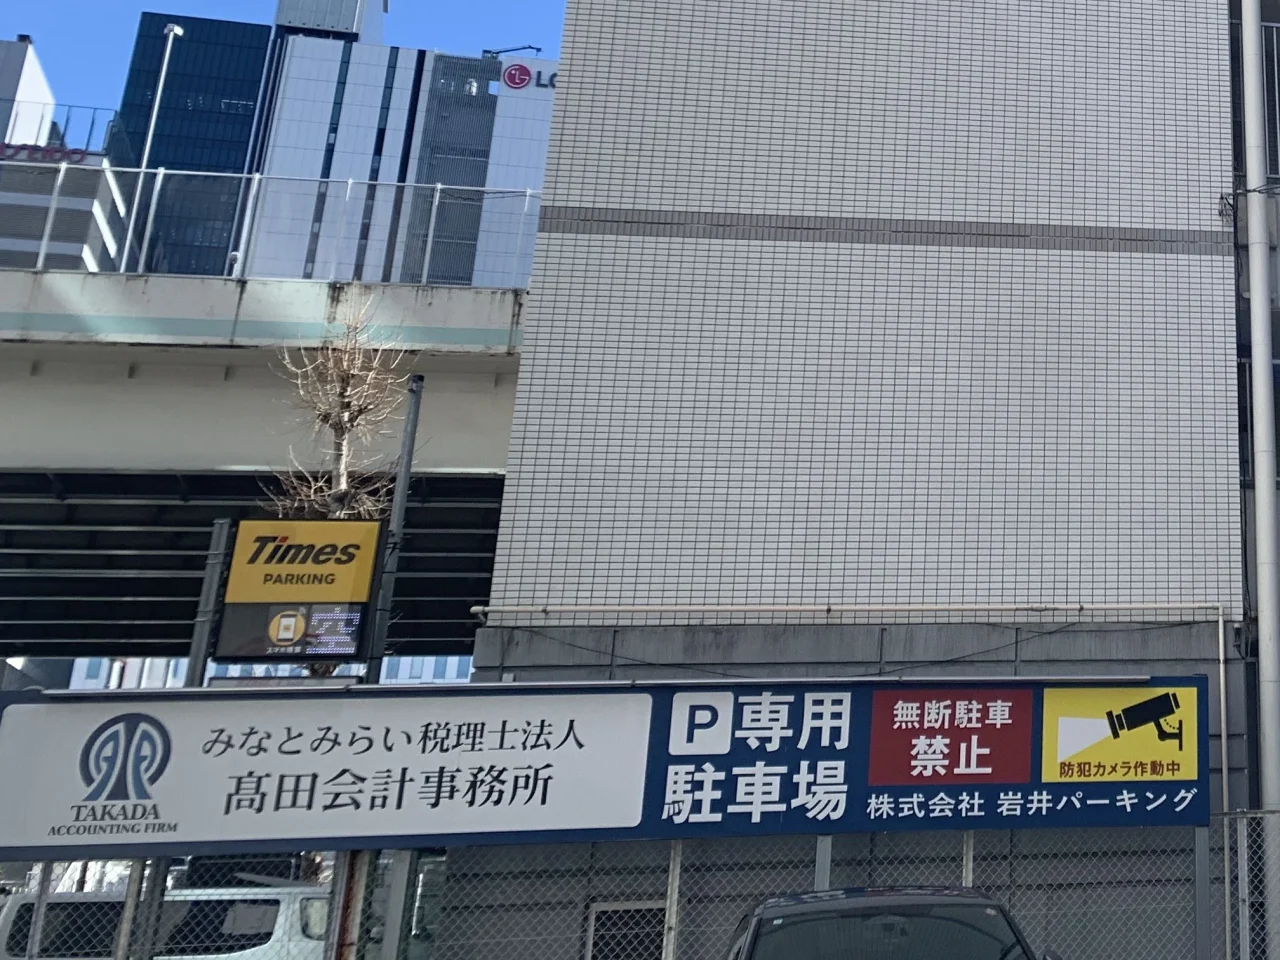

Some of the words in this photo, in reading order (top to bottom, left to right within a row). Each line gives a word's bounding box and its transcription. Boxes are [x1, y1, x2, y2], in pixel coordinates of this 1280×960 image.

[246, 536, 360, 565] Times
[262, 573, 336, 585] PARKING
[306, 607, 361, 654] 空
[686, 704, 719, 744] P
[735, 691, 851, 752] 専用
[893, 699, 1013, 730] 無断駐車
[202, 719, 585, 758] みなとみらい税理士法人
[909, 734, 993, 777] 禁止
[1059, 760, 1181, 779] 防犯カメラ作動中
[661, 760, 849, 824] 駐車場
[866, 790, 985, 820] 株式会社
[997, 786, 1198, 817] 岩井パーキング
[70, 803, 161, 822] TAKADA
[47, 823, 141, 836] ACCOUNTING
[144, 822, 179, 833] FIRM
